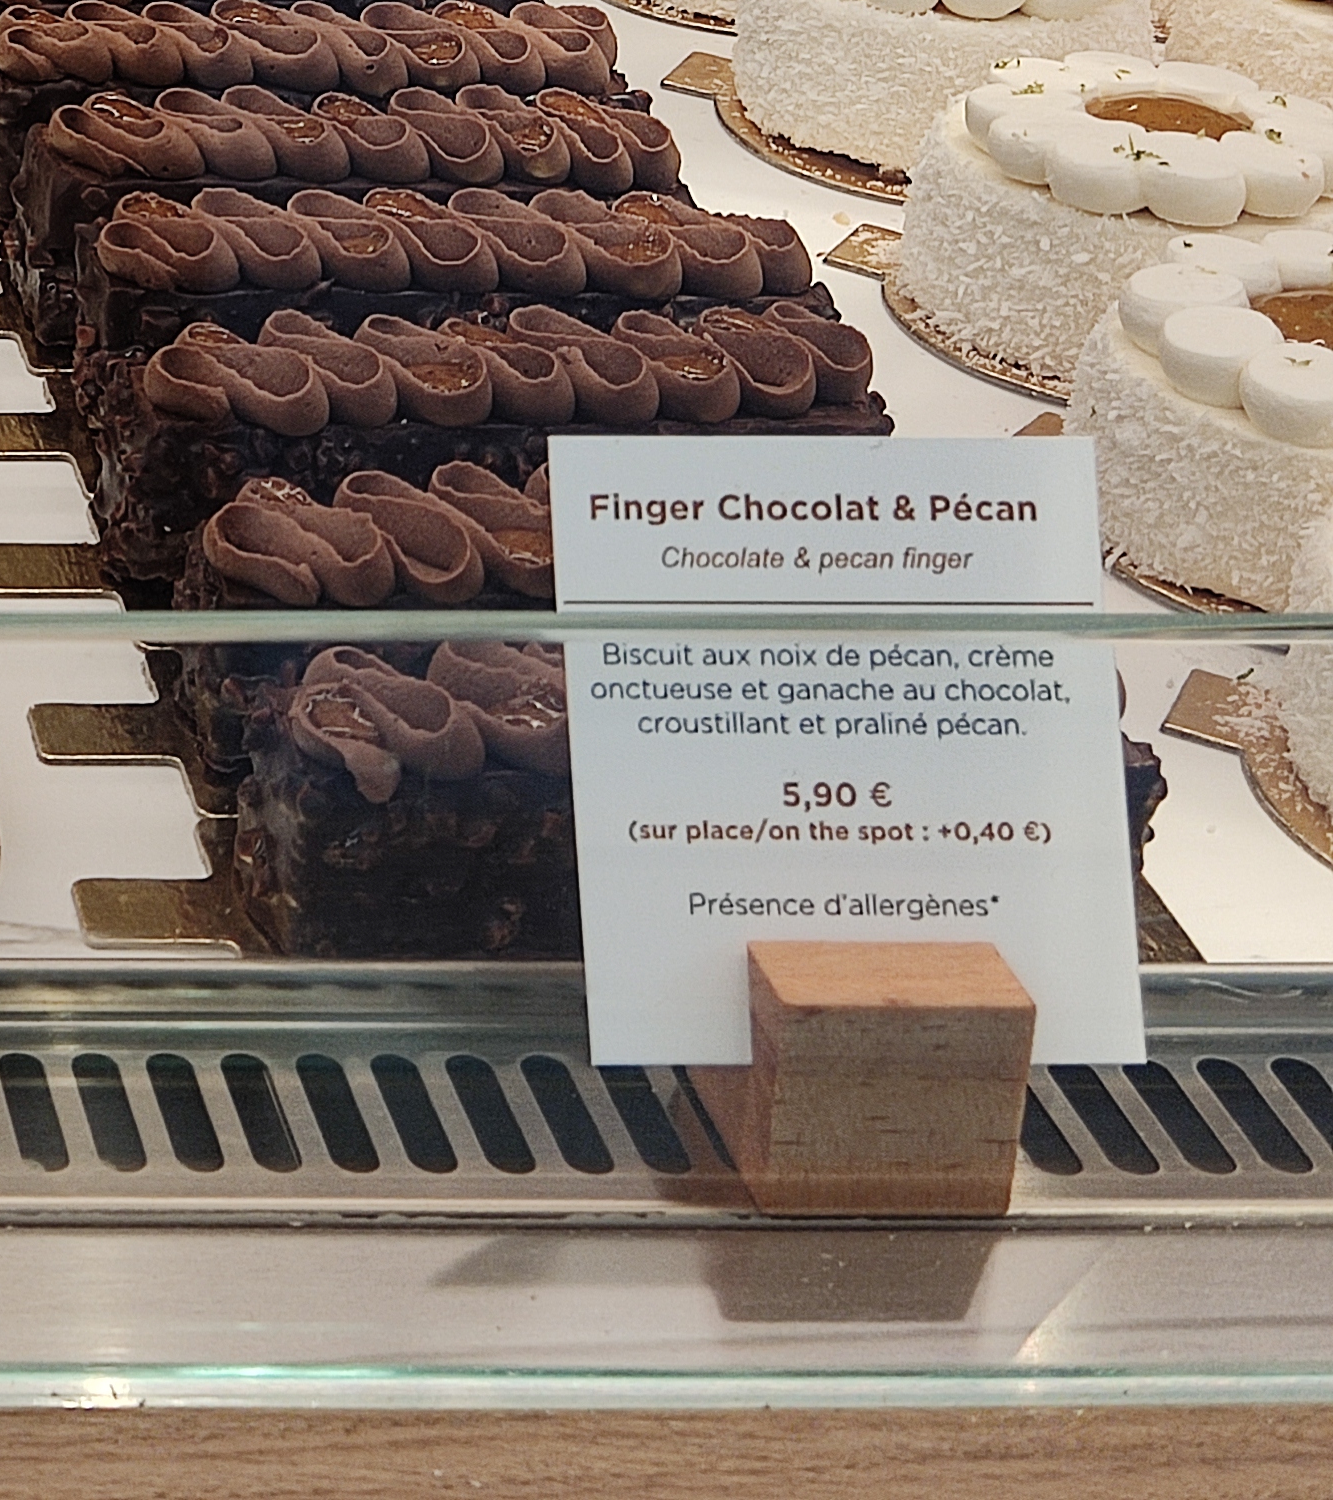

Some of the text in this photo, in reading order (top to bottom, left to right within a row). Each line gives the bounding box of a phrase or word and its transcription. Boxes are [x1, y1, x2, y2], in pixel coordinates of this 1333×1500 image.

[589, 492, 1038, 526] Finger Chocolat & Pécan
[661, 545, 974, 575] Chocolate & pecan finger
[602, 642, 1054, 671] Biscuit aux noix de pécan, crème
[590, 678, 1071, 705] onctueuse et ganache au chocolat,
[637, 711, 1027, 740] croustillant et praliné pécan.
[783, 781, 893, 813] 5,90 €
[628, 818, 1052, 846] (sur place/on the spot : +0,40 €)
[688, 891, 815, 916] Présence
